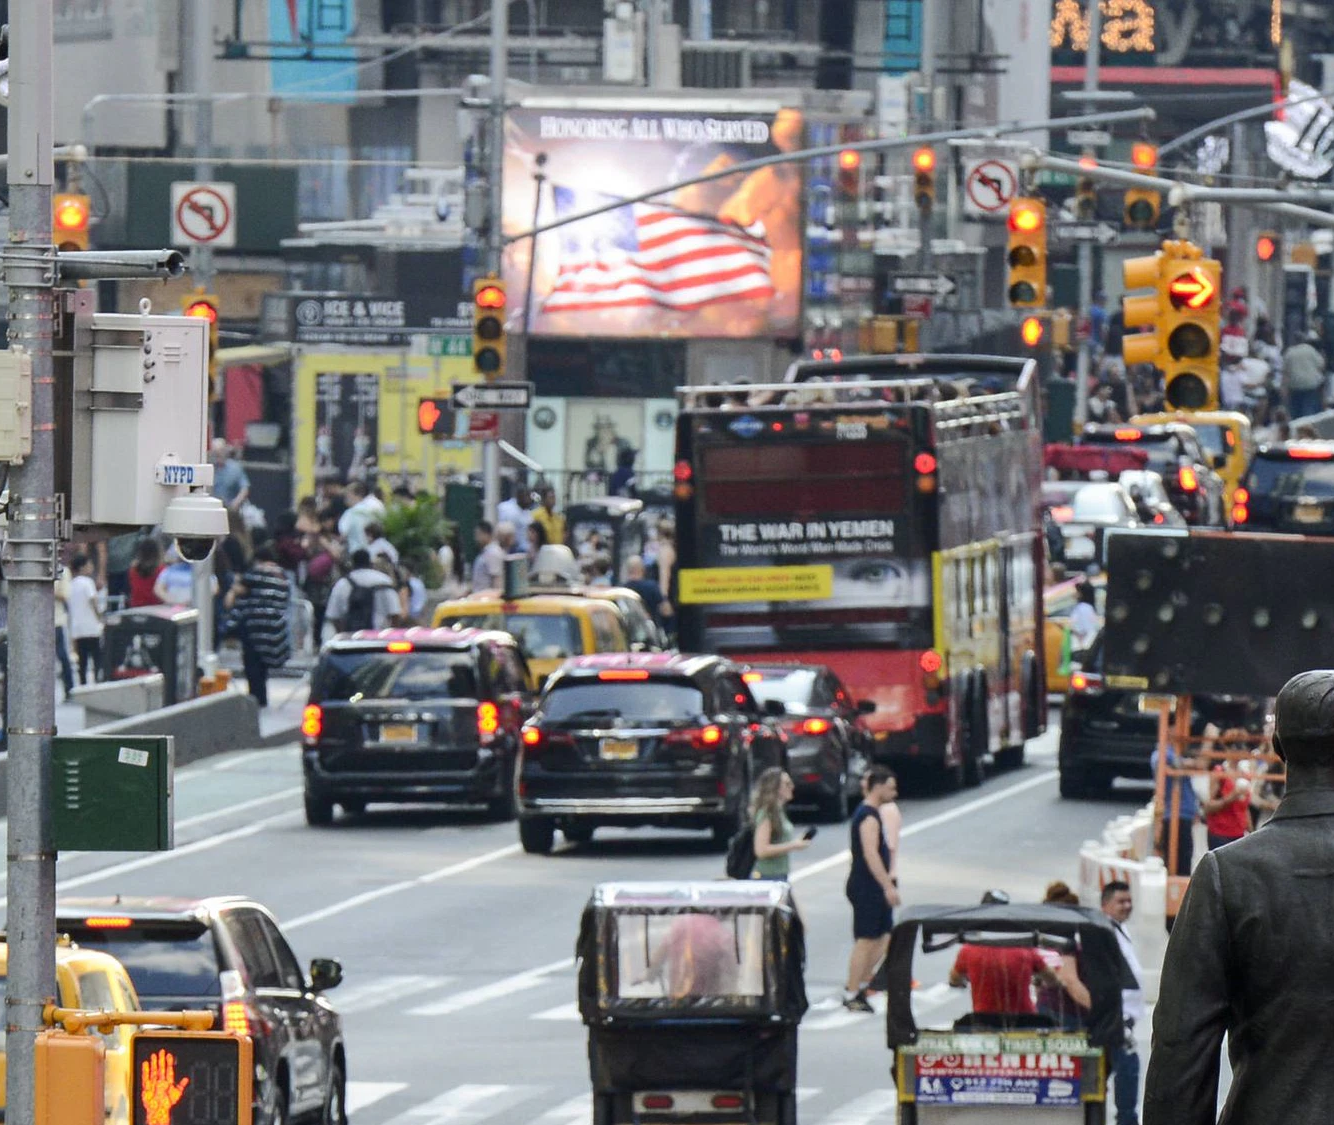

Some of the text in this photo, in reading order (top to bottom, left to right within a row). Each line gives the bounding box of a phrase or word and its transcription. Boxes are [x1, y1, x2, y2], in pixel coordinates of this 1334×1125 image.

[164, 465, 194, 484] NYPD
[719, 519, 894, 542] THE WAR IN YEMEN
